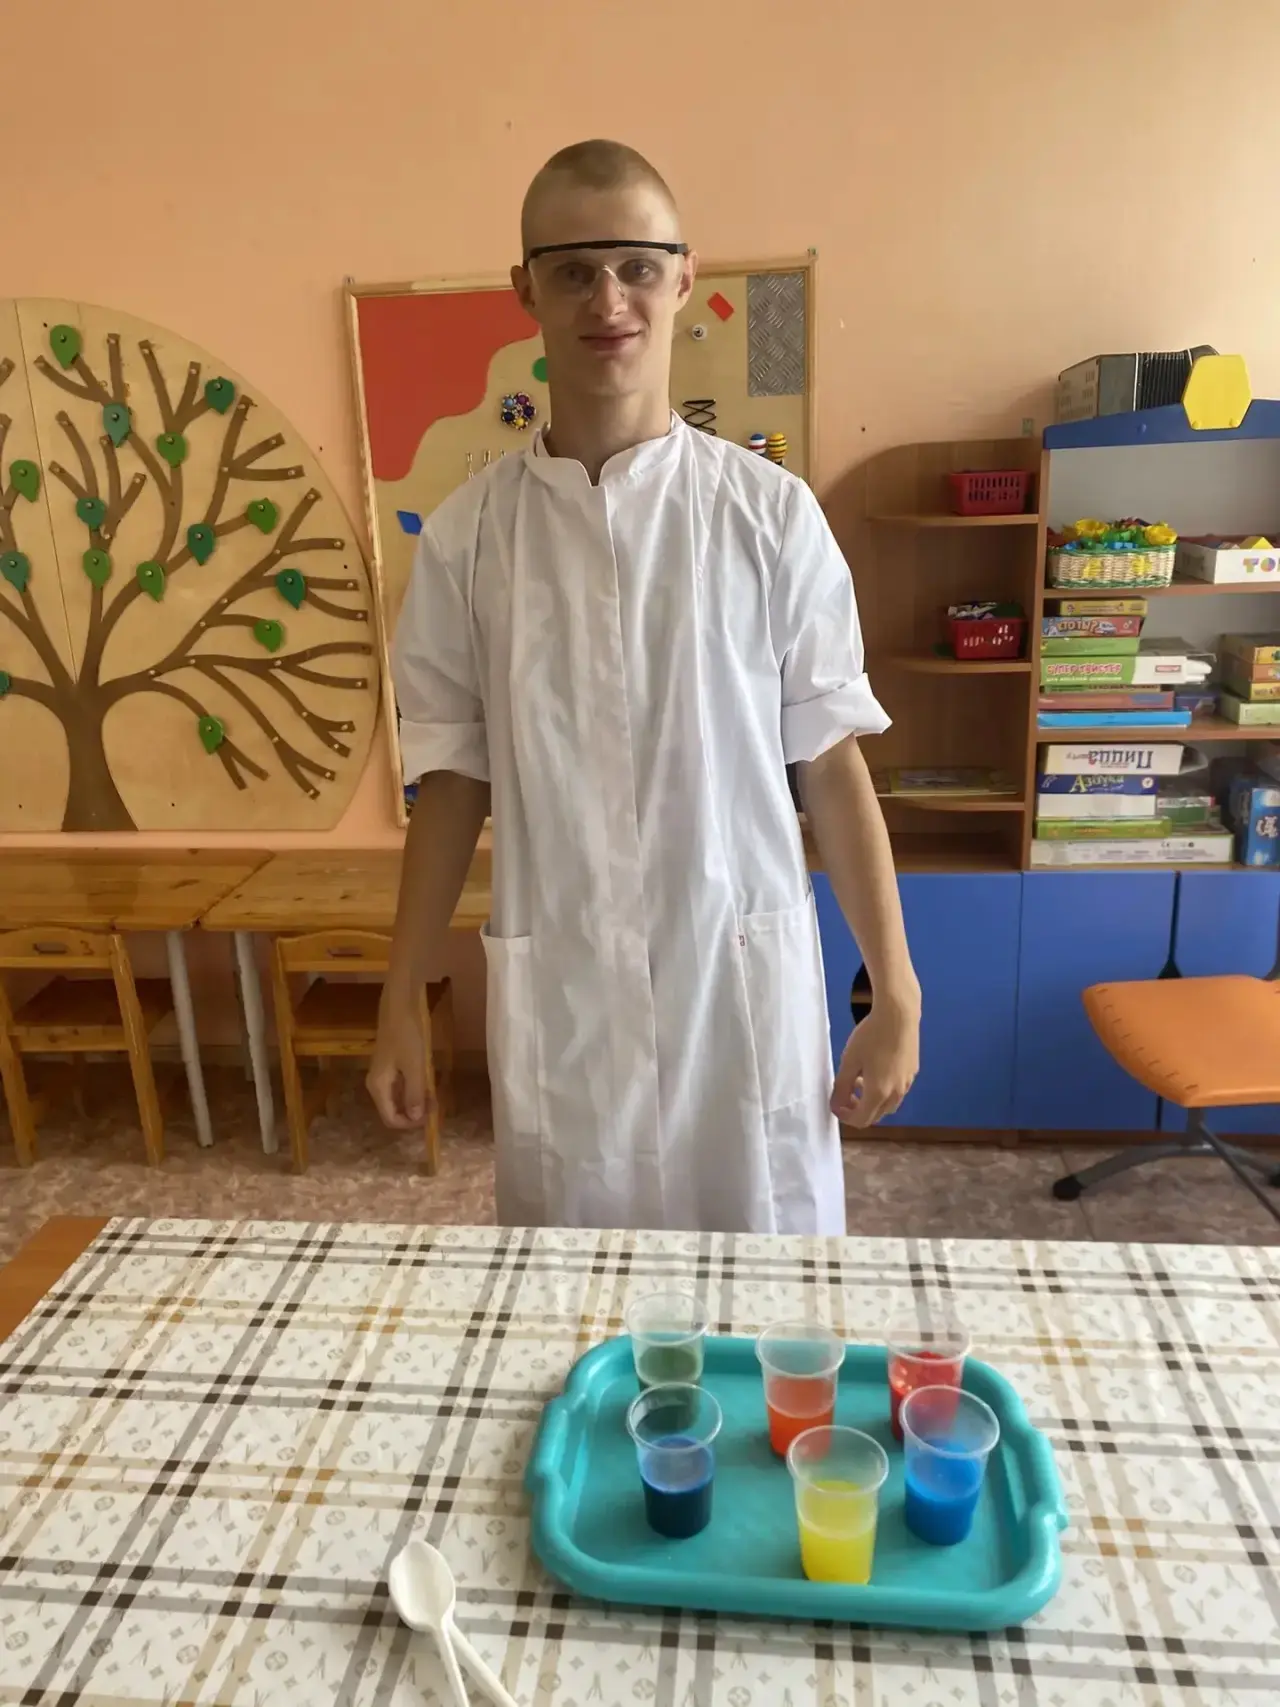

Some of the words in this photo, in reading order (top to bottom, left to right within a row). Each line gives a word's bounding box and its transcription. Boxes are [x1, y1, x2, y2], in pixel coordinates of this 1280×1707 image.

[1046, 664, 1079, 676] СУПЕР
[1079, 662, 1123, 676] ТВИСТЕР
[1088, 750, 1154, 769] Пицца
